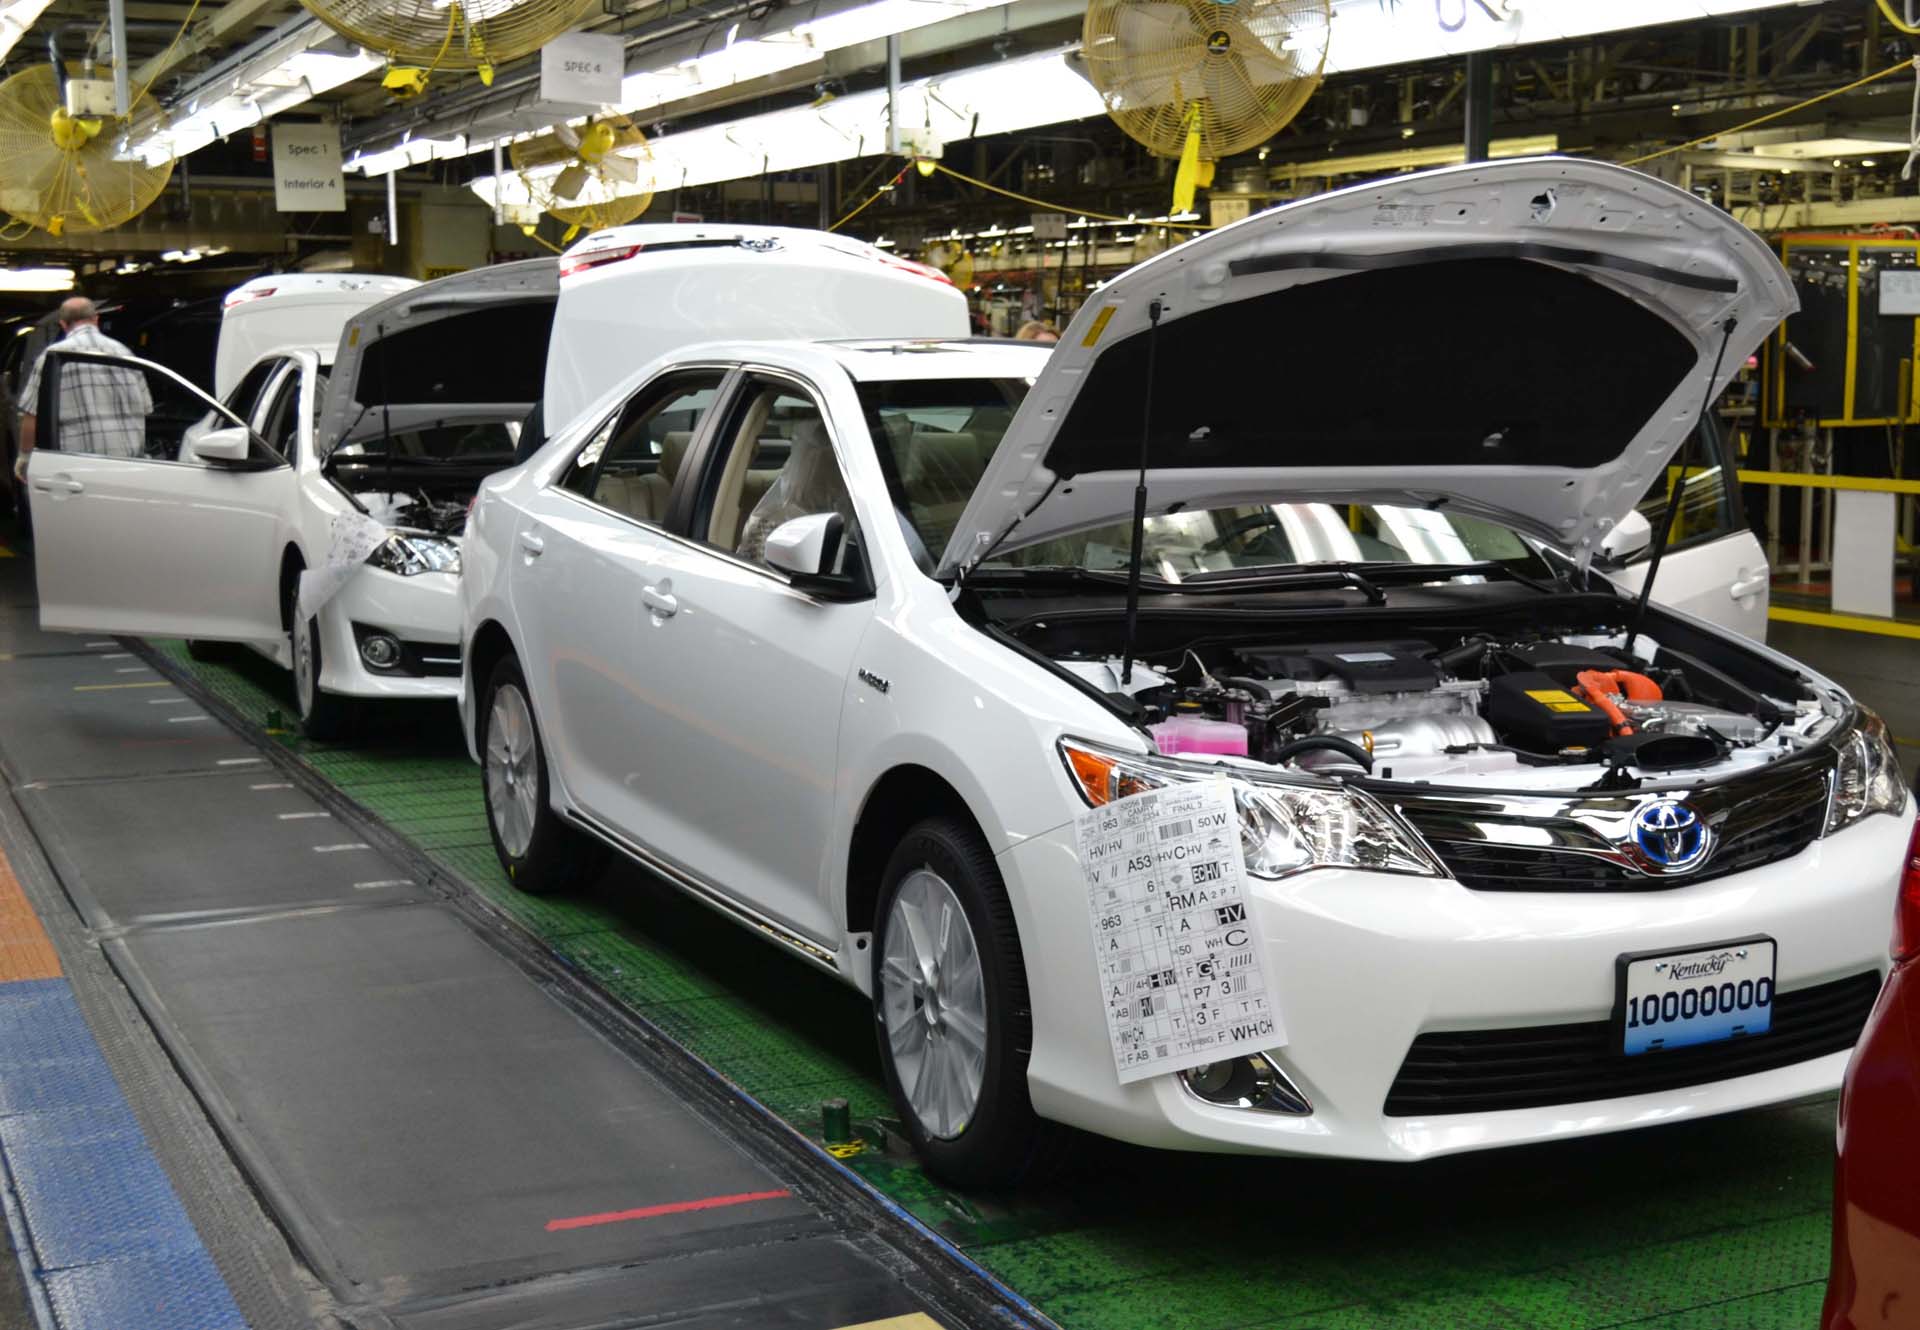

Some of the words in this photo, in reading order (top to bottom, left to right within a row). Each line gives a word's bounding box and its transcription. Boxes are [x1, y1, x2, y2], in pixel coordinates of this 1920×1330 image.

[564, 61, 592, 73] SPEC
[594, 63, 602, 73] 4
[288, 144, 319, 156] Spec
[284, 179, 325, 189] Interior
[1102, 817, 1119, 831] 963
[1198, 817, 1212, 828] 50
[1212, 812, 1227, 826] W
[1128, 854, 1152, 874] A53
[1146, 880, 1155, 893] 6
[1101, 914, 1122, 930] 963
[1180, 918, 1192, 933] A
[1669, 959, 1726, 980] Kentucky
[1193, 984, 1212, 1001] P7
[1220, 981, 1231, 995] 3
[1628, 976, 1775, 1029] 10000000
[1196, 1011, 1207, 1025] 3
